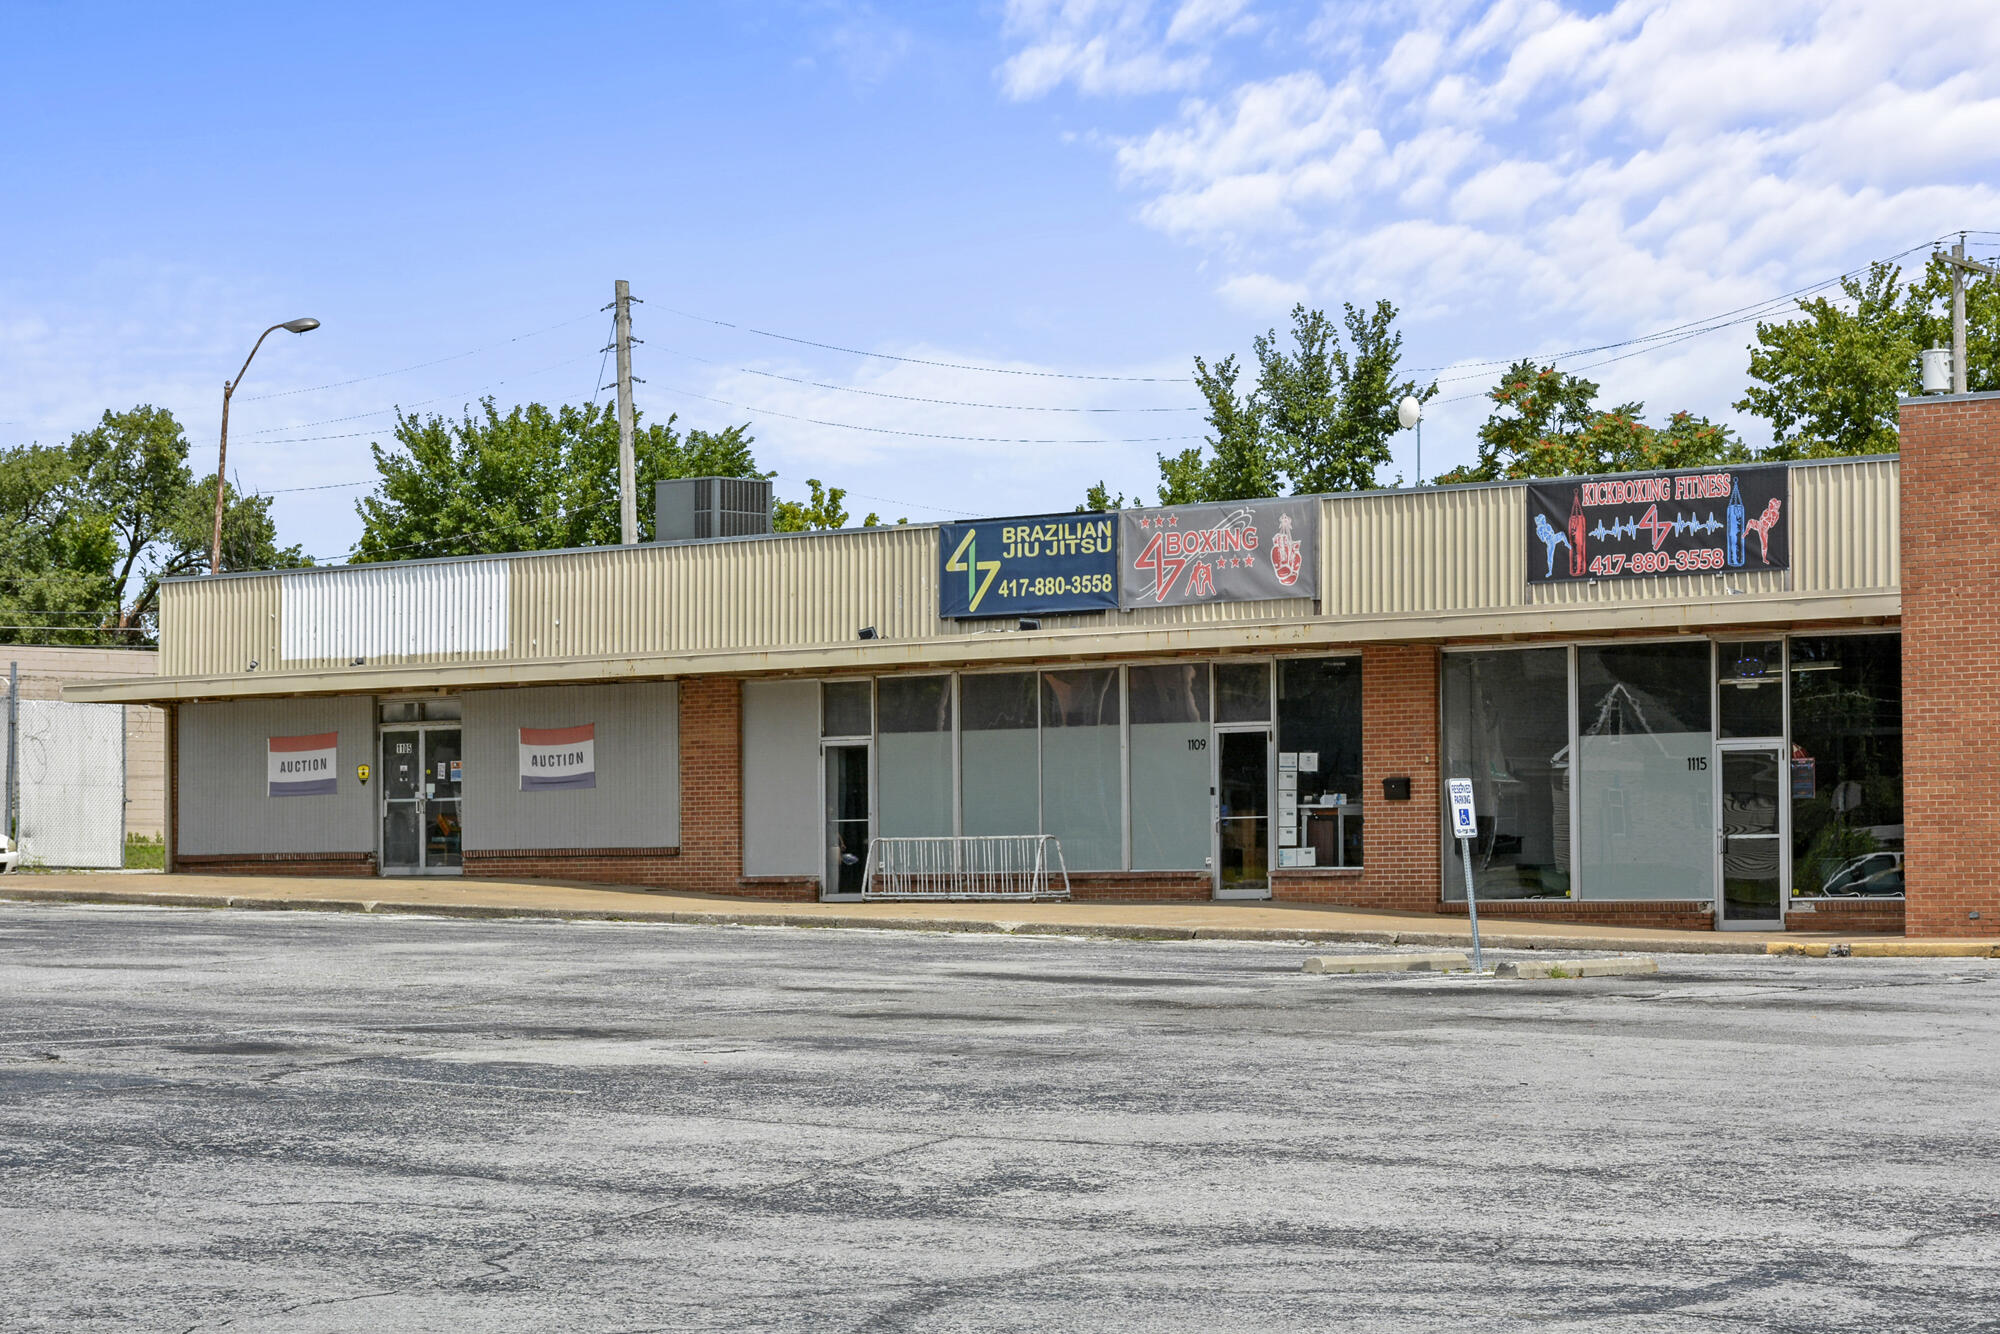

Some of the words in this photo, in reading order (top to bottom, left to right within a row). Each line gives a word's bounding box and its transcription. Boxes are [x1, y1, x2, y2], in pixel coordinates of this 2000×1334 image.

[1581, 477, 1671, 507] KICKBOXING
[1674, 473, 1732, 499] FITNESS
[1002, 520, 1112, 544] BRAZILIAN
[1165, 527, 1259, 556] BOXING
[1003, 542, 1040, 559] JIU
[1045, 537, 1112, 556] JITSU
[1589, 549, 1725, 576] 417-880-3558
[998, 573, 1113, 598] 417-880-3558
[1188, 739, 1206, 751] 1109
[280, 757, 327, 774] AUCTION
[531, 751, 584, 768] AUCTION
[1687, 757, 1708, 771] 1115
